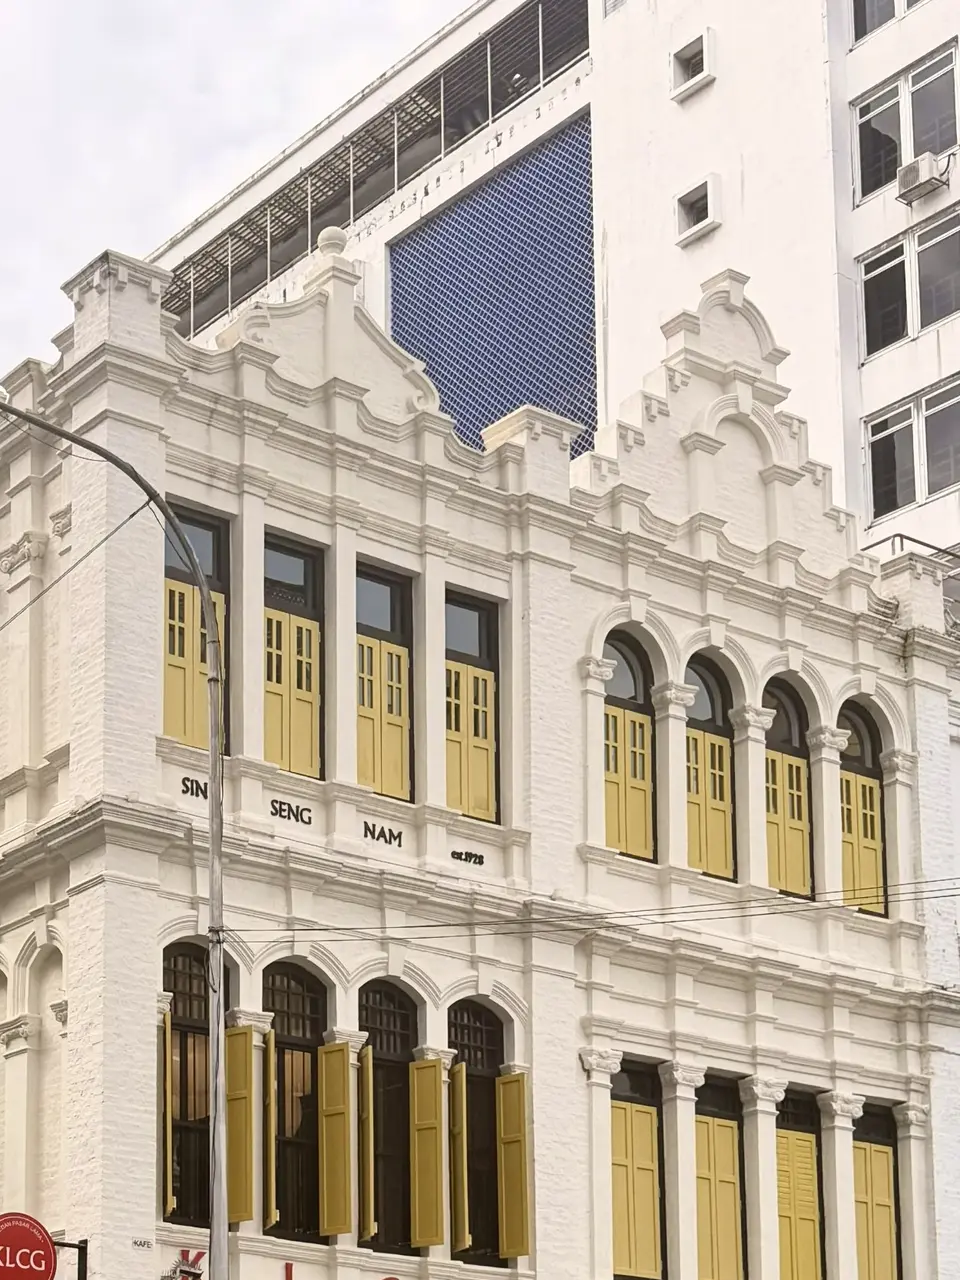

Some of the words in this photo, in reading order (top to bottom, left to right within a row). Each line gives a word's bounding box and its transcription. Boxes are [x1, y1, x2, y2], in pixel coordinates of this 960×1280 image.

[182, 777, 208, 800] SIN
[270, 800, 312, 825] SENG
[364, 821, 402, 848] NAM
